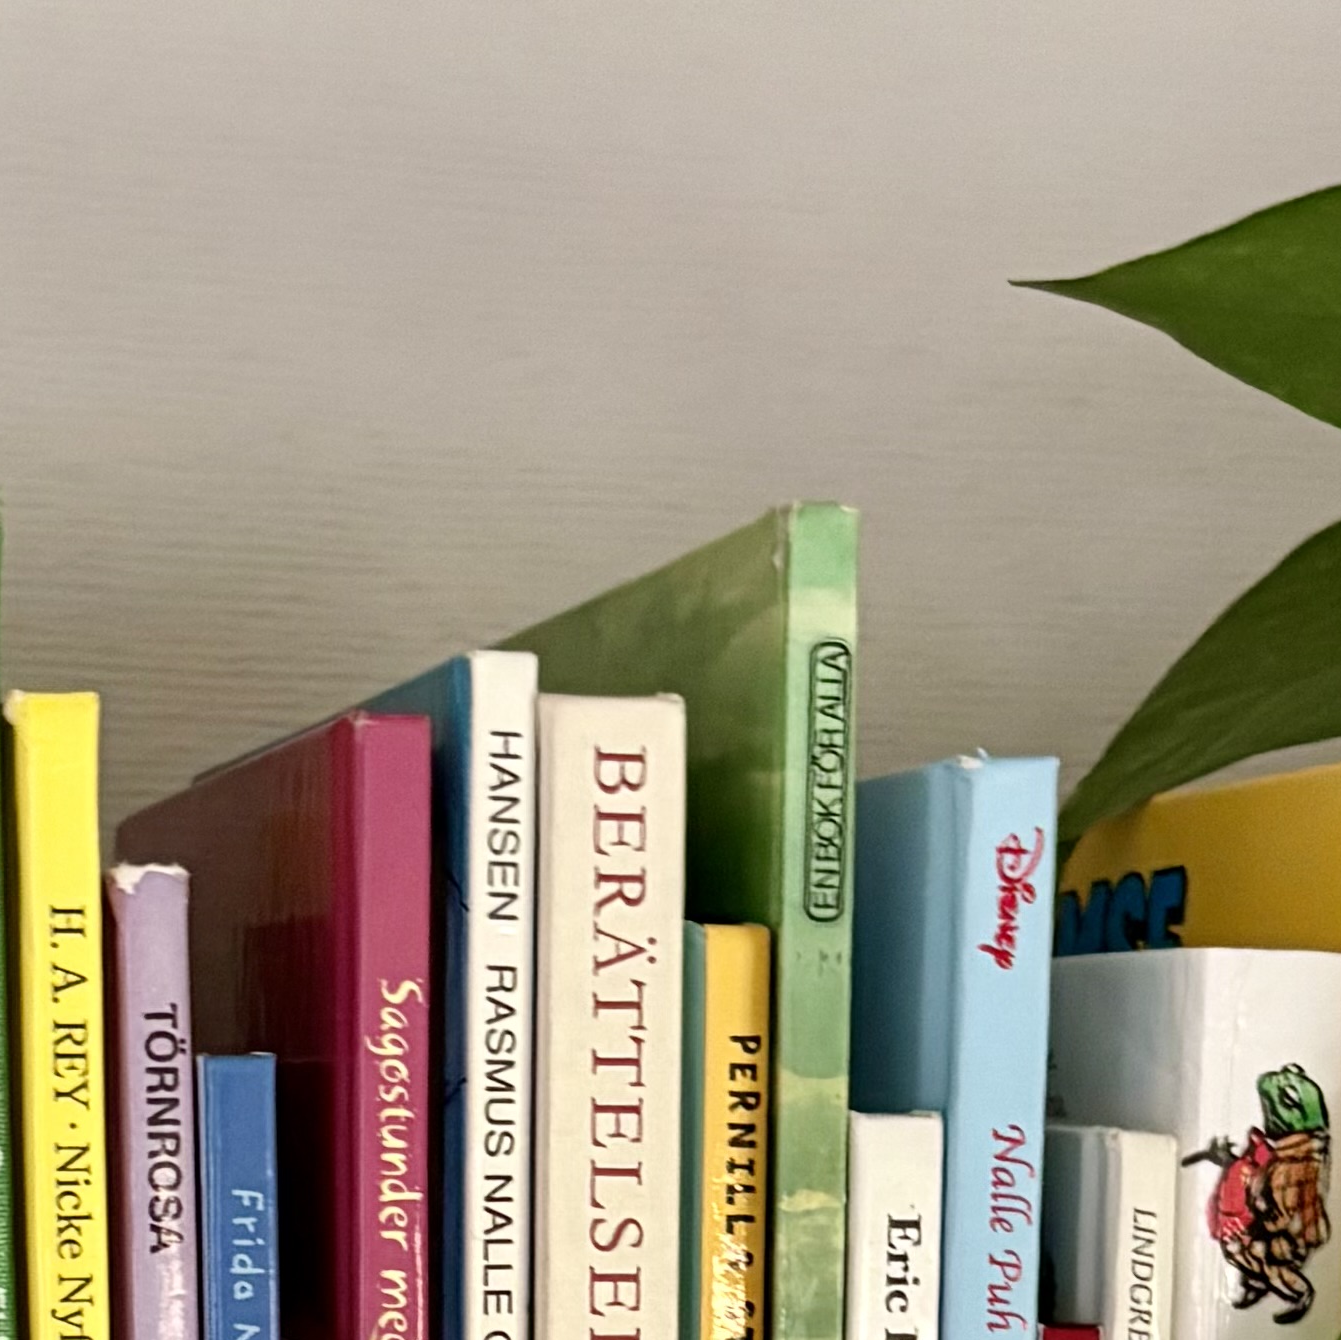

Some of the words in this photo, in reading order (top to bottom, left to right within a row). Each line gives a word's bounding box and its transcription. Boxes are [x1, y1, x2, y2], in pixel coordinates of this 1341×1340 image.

[486, 728, 524, 922] HANSEN
[978, 826, 1044, 971] Disney
[53, 1020, 90, 1111] REY
[365, 979, 423, 1248] Sagostunder
[483, 964, 519, 1157] RASMUS
[143, 1003, 187, 1255] TÖRNROSA
[990, 1123, 1035, 1234] Nalle
[56, 1142, 91, 1260] Nicke
[229, 1190, 264, 1300] Frida
[483, 1174, 515, 1317] NALLE
[885, 1212, 923, 1314] Eric
[984, 1249, 1028, 1333] Puh
